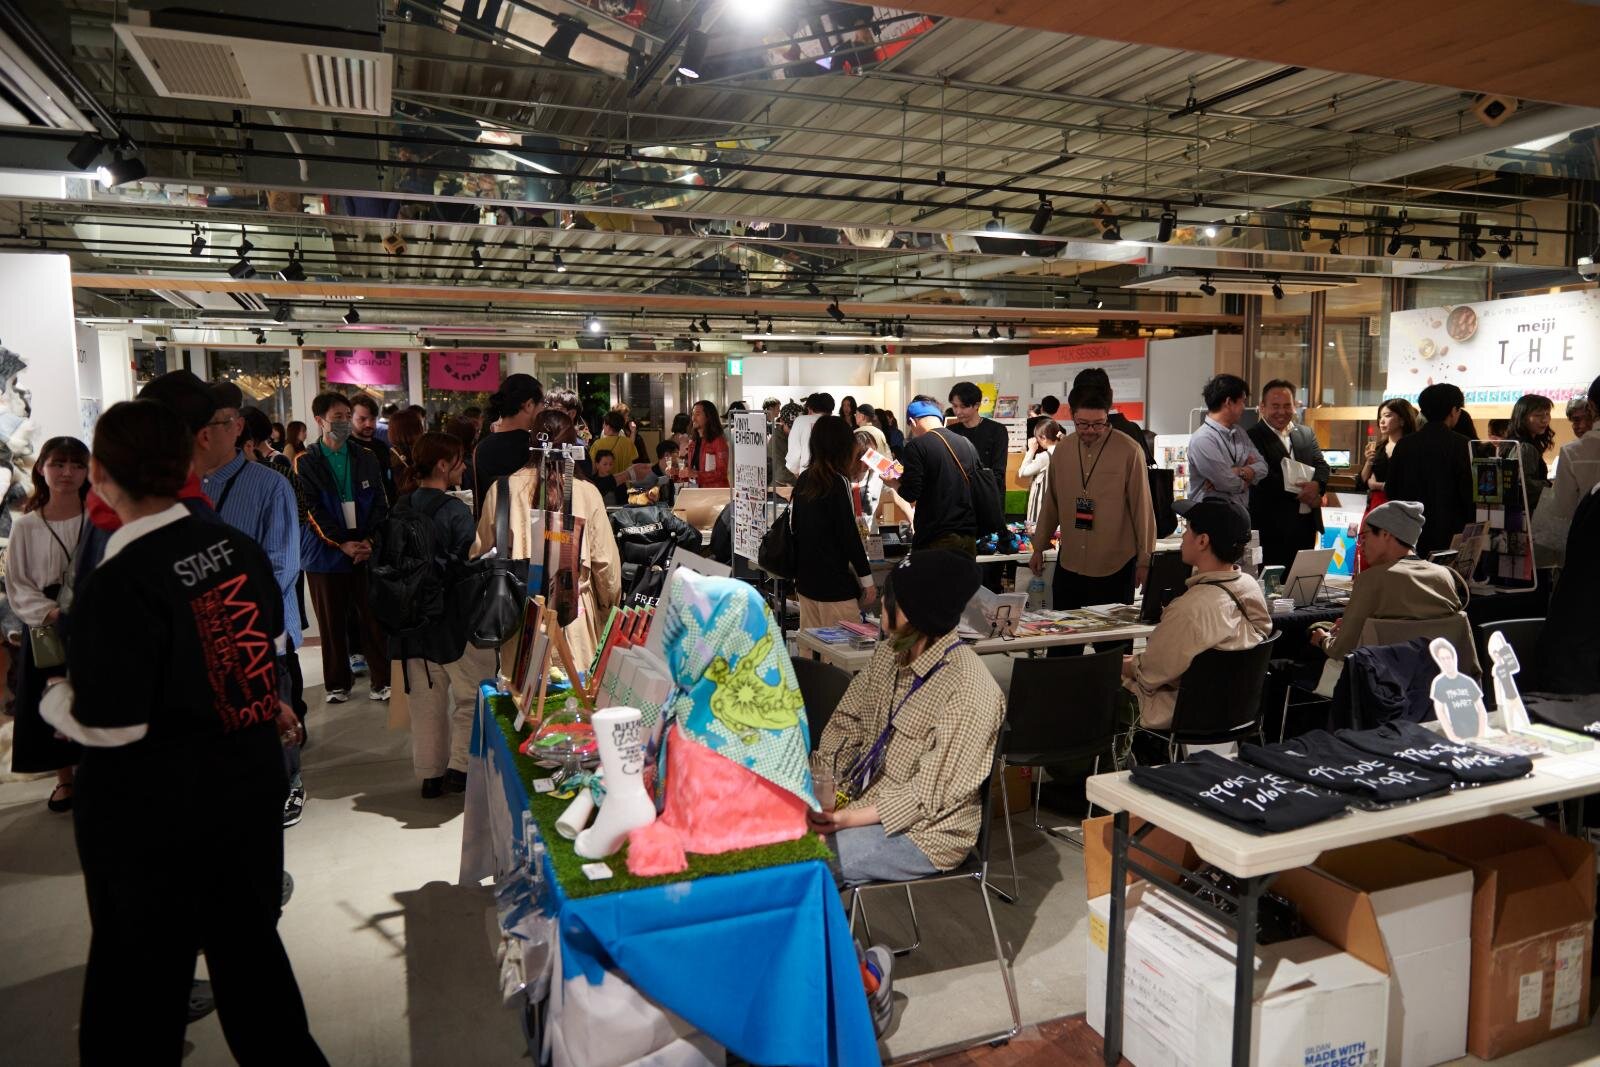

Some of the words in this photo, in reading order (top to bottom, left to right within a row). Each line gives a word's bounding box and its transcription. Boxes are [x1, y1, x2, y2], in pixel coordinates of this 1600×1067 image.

[1517, 317, 1556, 334] meiji
[1057, 349, 1074, 360] TALK
[1075, 346, 1111, 359] SESSION
[334, 358, 392, 366] DIGGING
[1509, 352, 1558, 376] Cacao
[735, 418, 750, 431] VINYL
[735, 431, 764, 446] EXHIBITION
[173, 539, 234, 587] STAFF
[218, 573, 276, 693] MYAF
[1304, 1042, 1331, 1055] GILDAN
[1304, 1049, 1337, 1065] MADE
[1338, 1041, 1366, 1057] WITH
